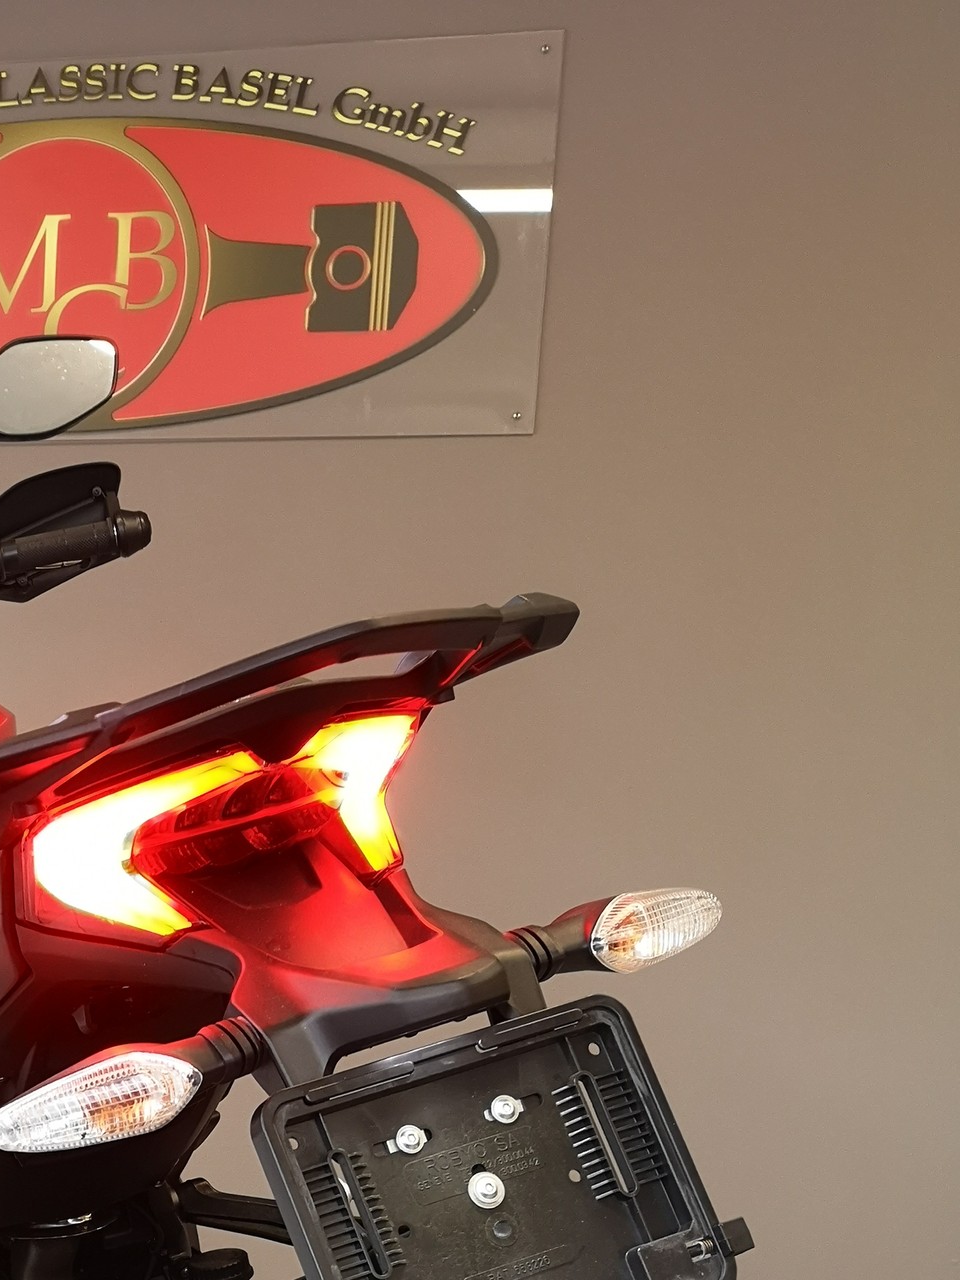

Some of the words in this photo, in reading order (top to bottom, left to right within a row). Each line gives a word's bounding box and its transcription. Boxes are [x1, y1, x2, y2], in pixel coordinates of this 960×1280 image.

[171, 63, 320, 117] BASEL
[331, 86, 478, 157] GmbH
[493, 1132, 521, 1152] SA
